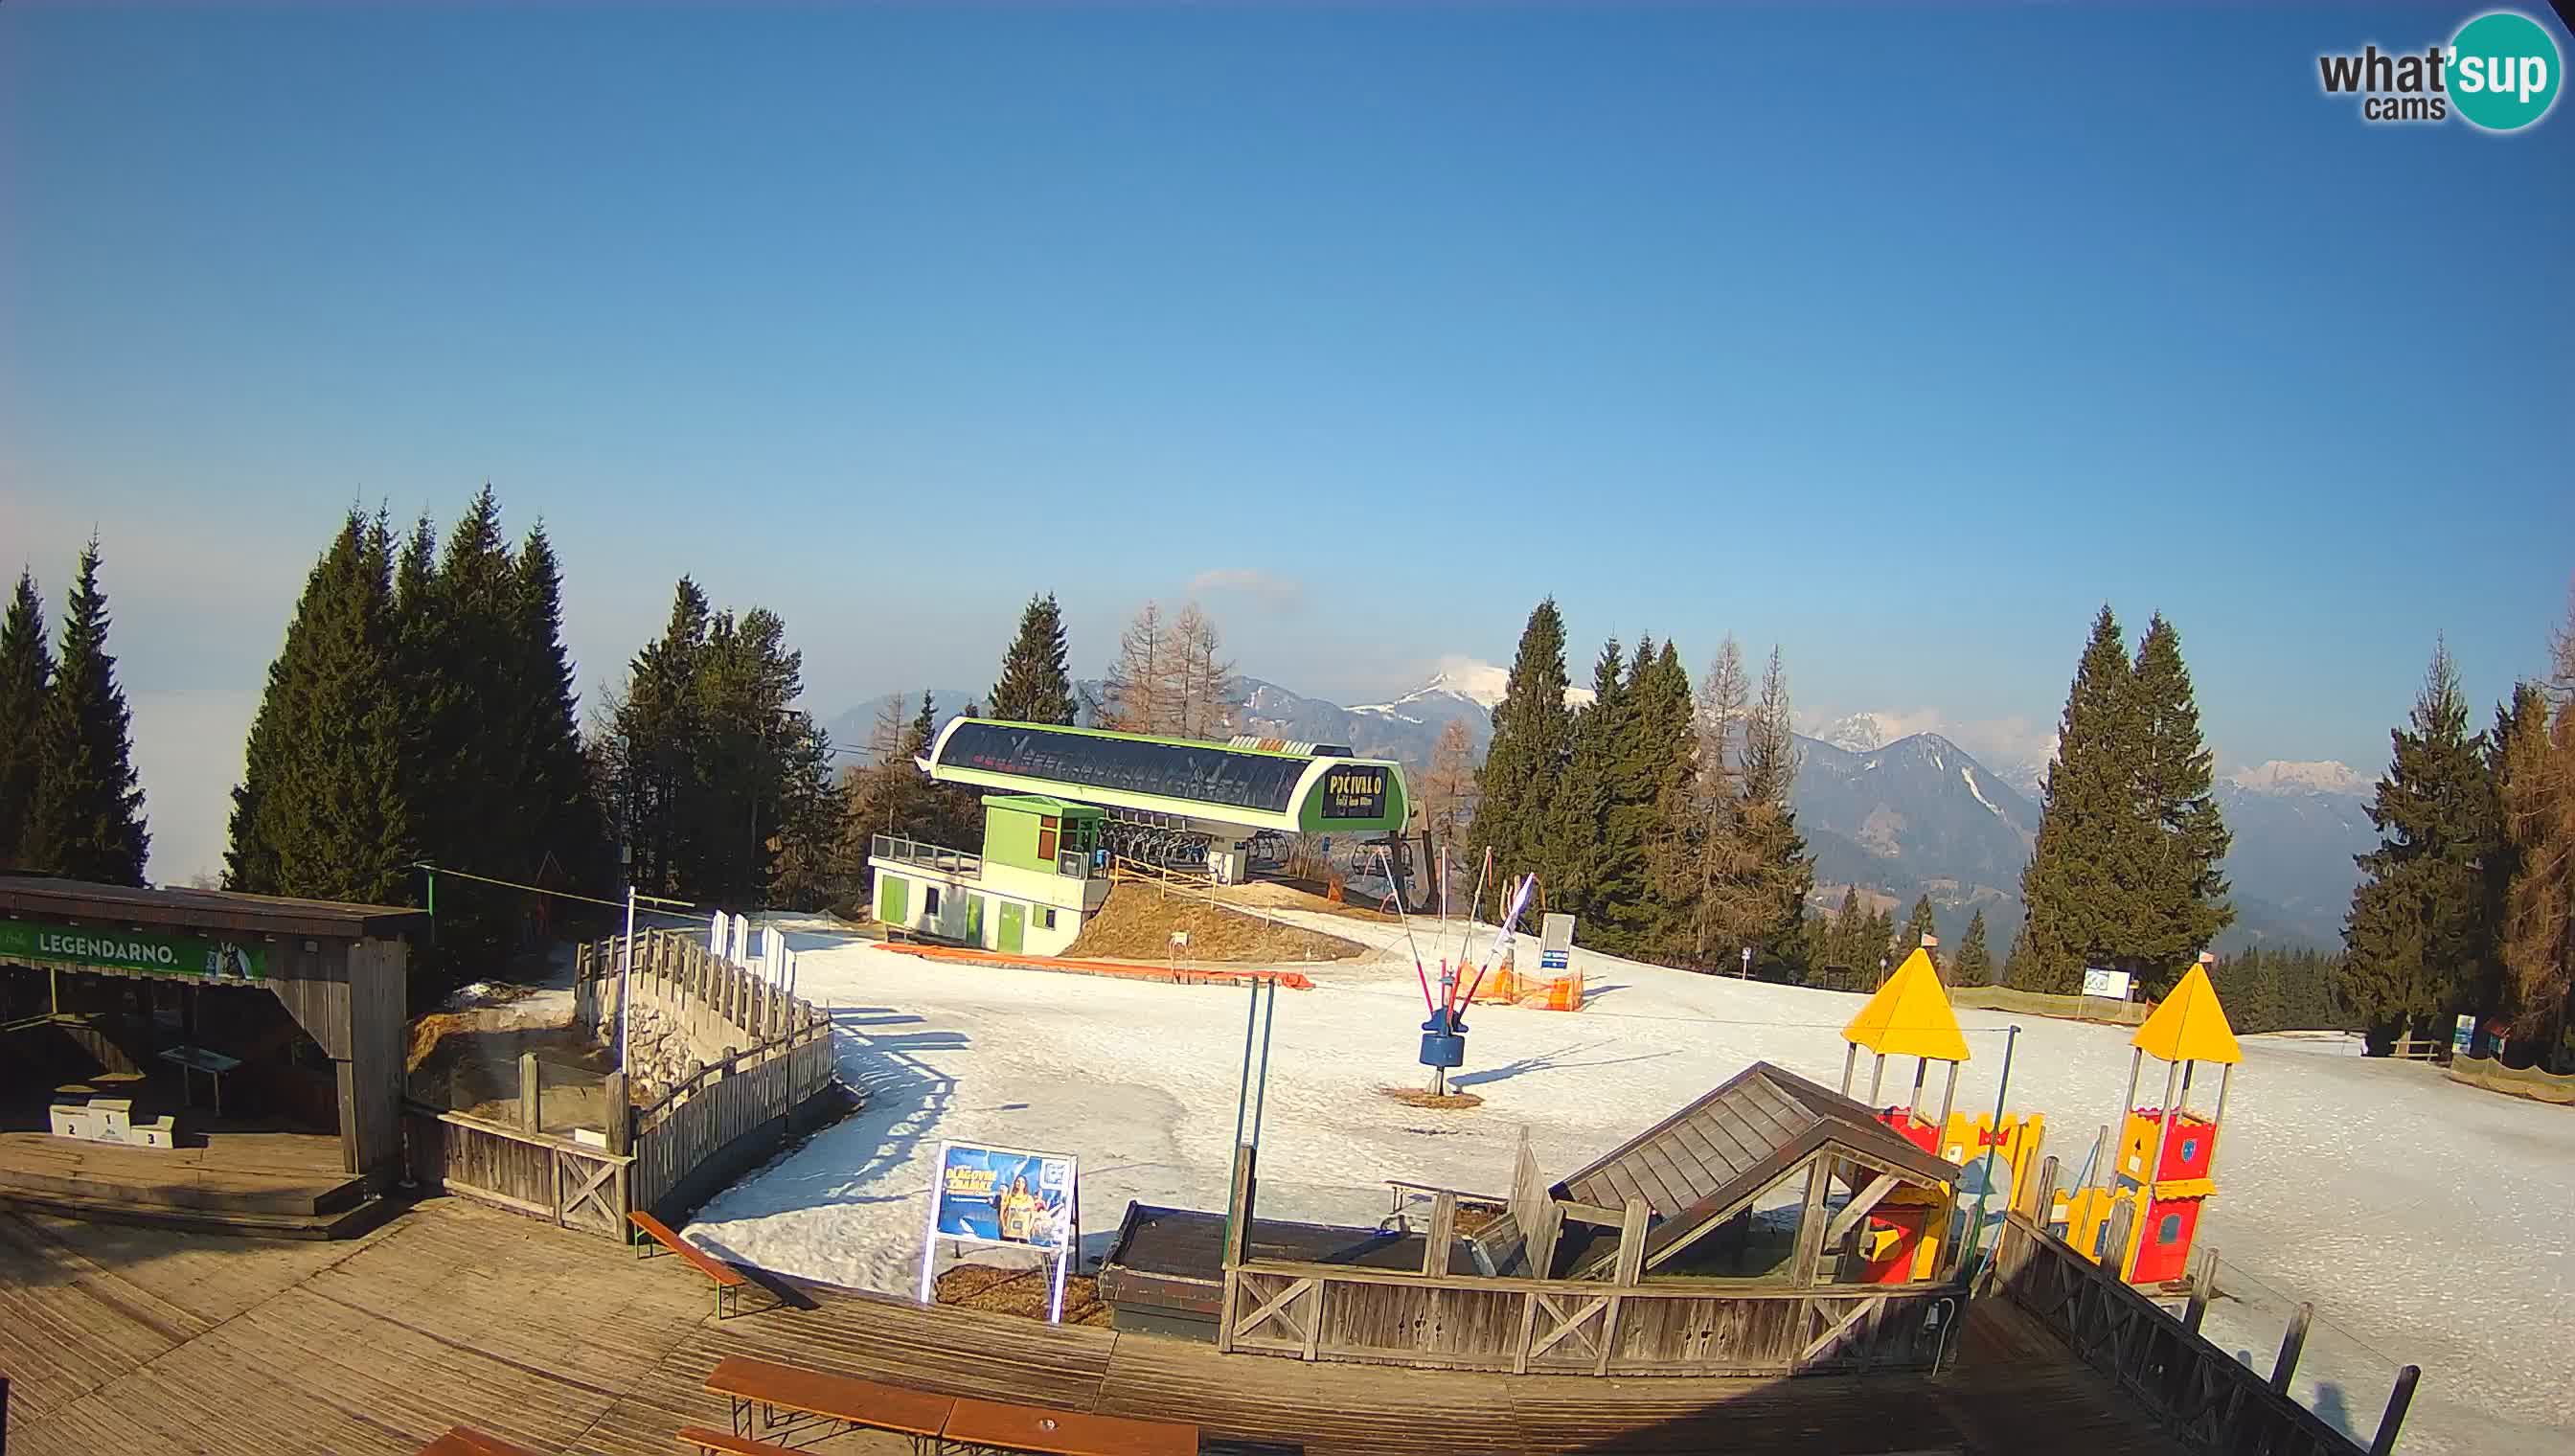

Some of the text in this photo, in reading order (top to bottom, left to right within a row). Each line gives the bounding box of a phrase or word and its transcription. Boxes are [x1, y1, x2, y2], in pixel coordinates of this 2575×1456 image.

[38, 932, 179, 965] LEGENDARNO.
[104, 1113, 112, 1125] 1
[68, 1124, 76, 1135] 2
[148, 1133, 155, 1145] 3
